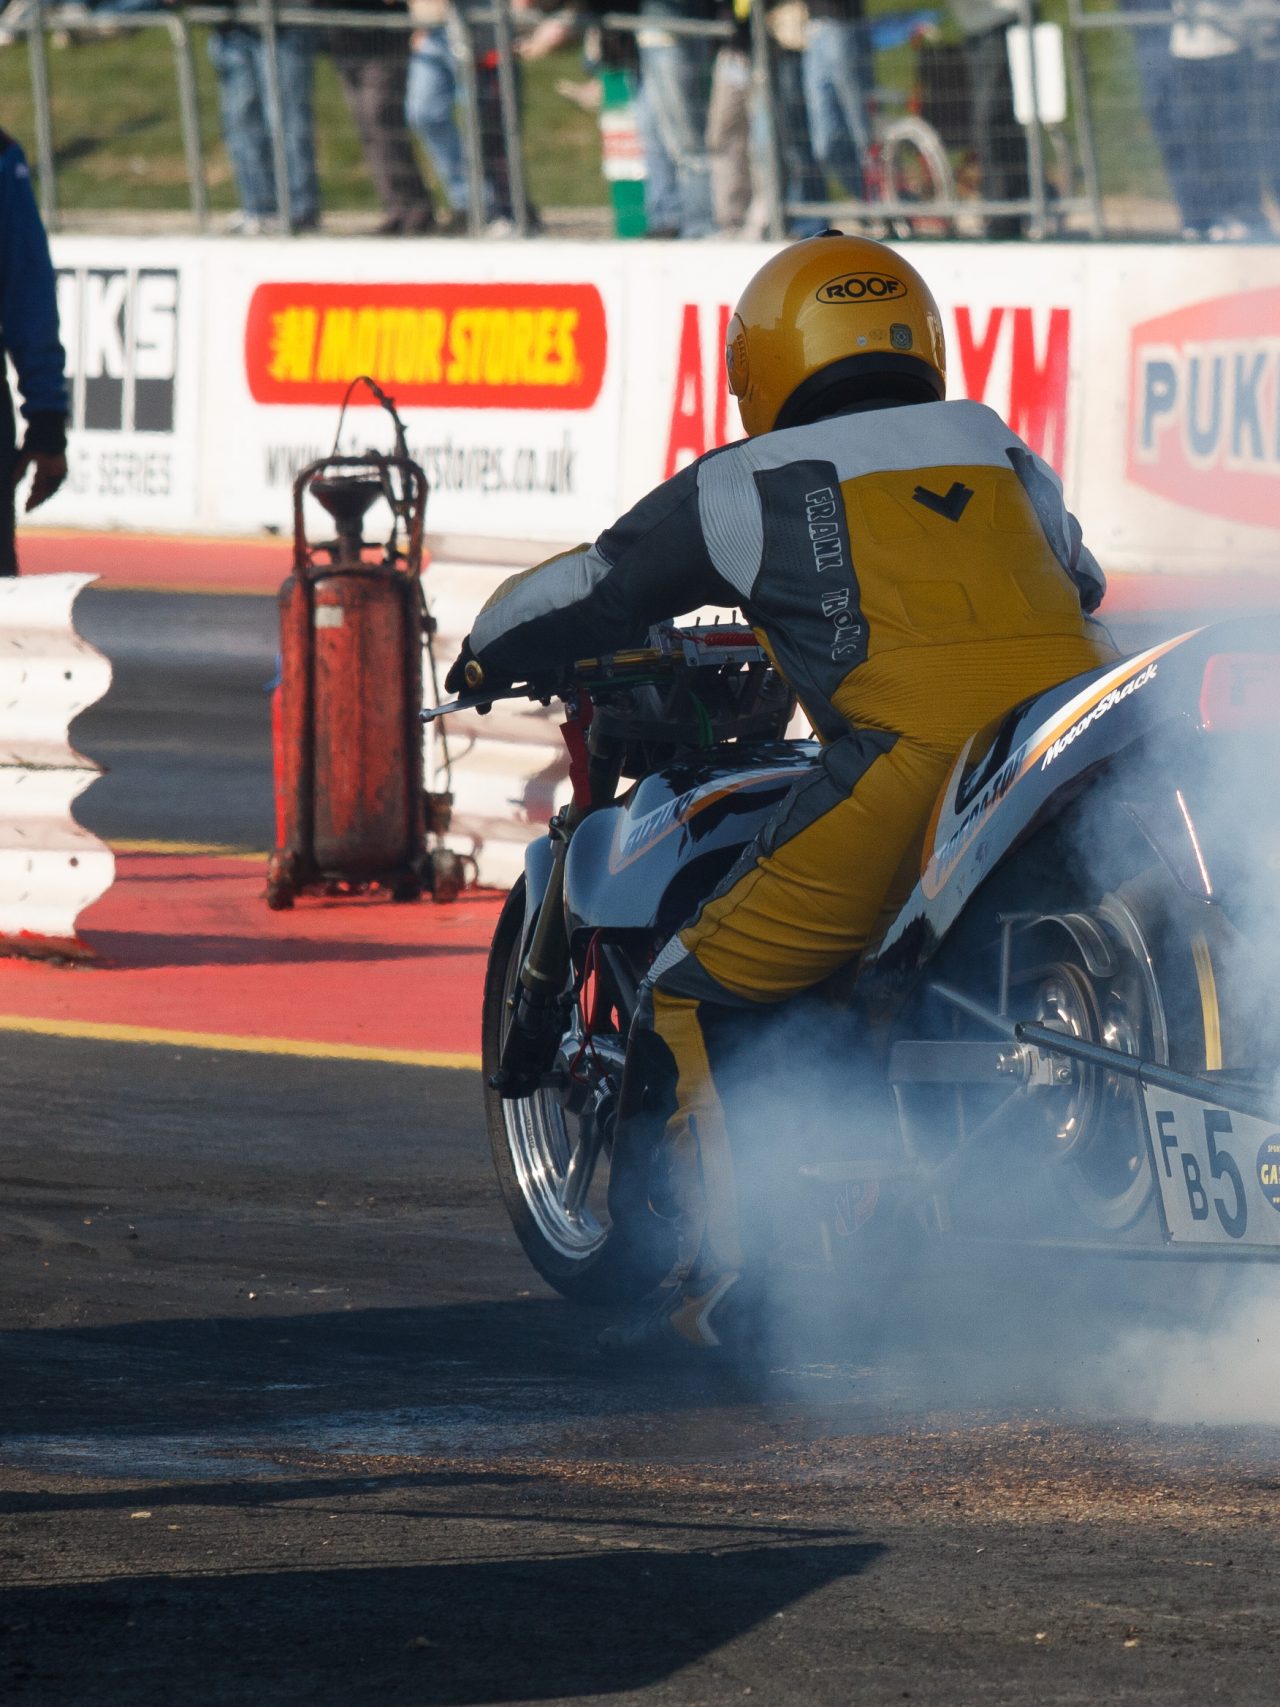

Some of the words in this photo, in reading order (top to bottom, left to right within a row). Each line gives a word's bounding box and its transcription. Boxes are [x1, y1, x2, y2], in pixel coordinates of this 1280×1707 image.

[826, 278, 898, 298] ROOF
[315, 305, 446, 383] MOTOR
[448, 306, 582, 385] STORES
[805, 487, 843, 572] FRANK
